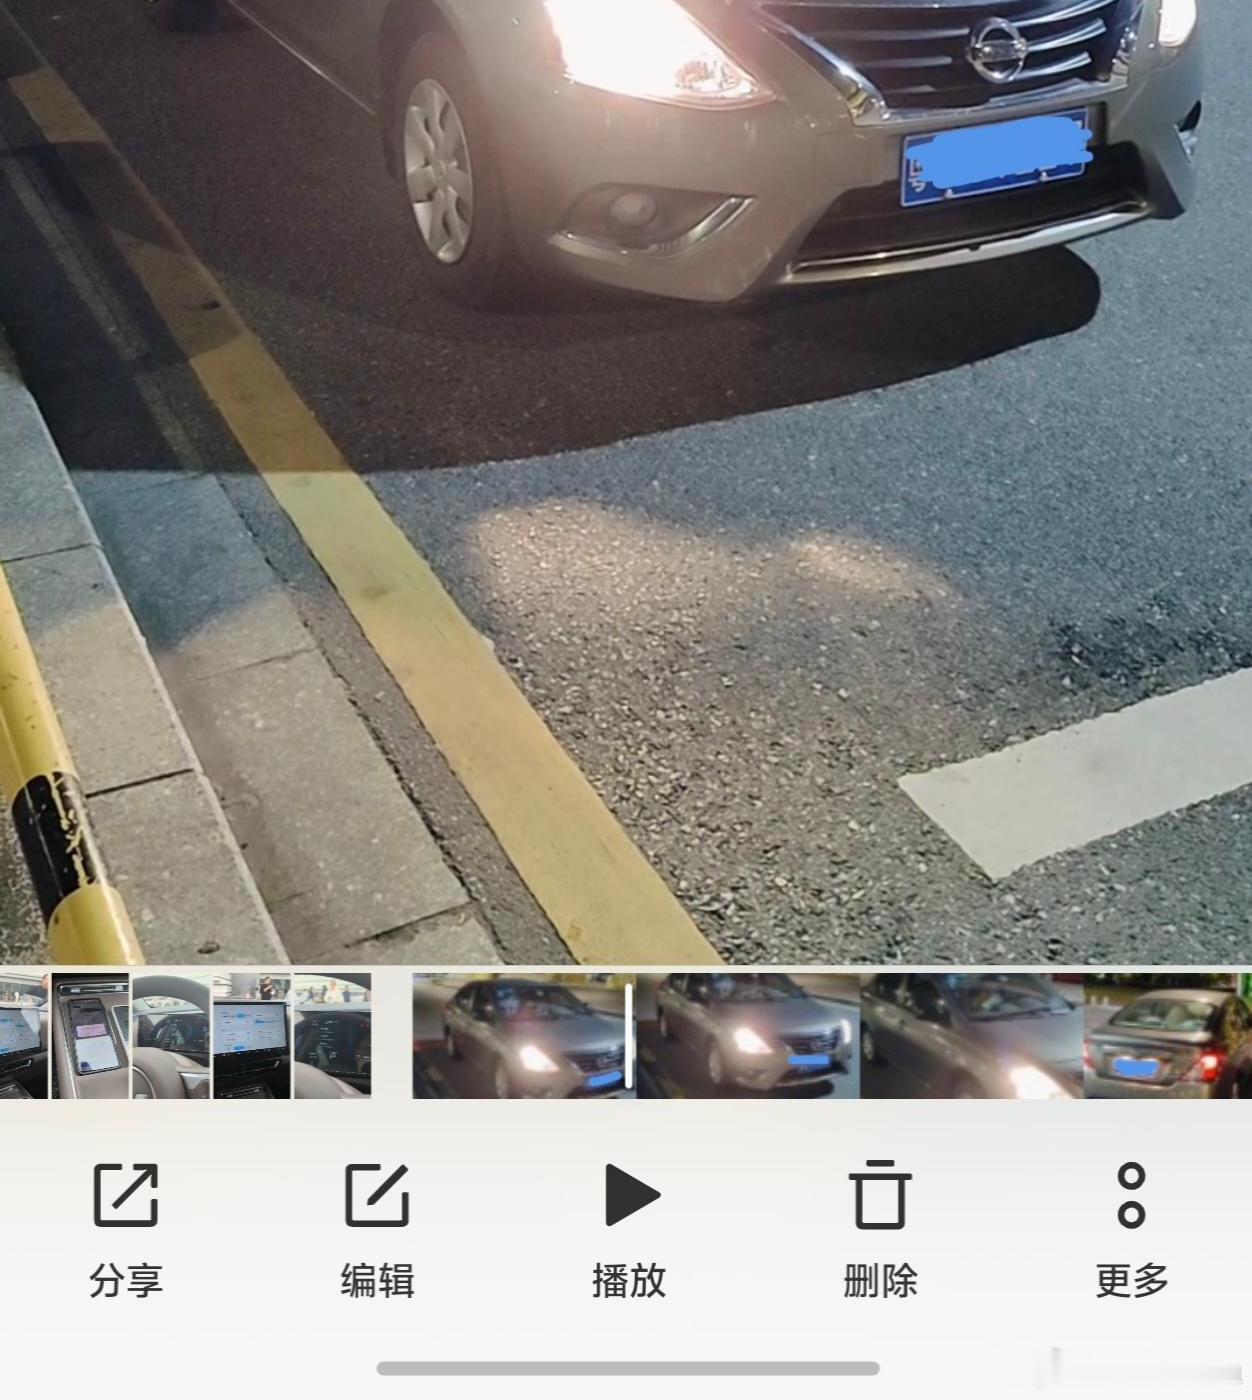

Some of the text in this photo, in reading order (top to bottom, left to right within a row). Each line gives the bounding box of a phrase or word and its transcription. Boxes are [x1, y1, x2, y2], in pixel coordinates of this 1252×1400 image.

[89, 1262, 163, 1299] 分享
[340, 1262, 415, 1299] 编辑
[592, 1262, 666, 1299] 播放
[844, 1262, 918, 1299] 删除
[1096, 1262, 1168, 1299] 更多
